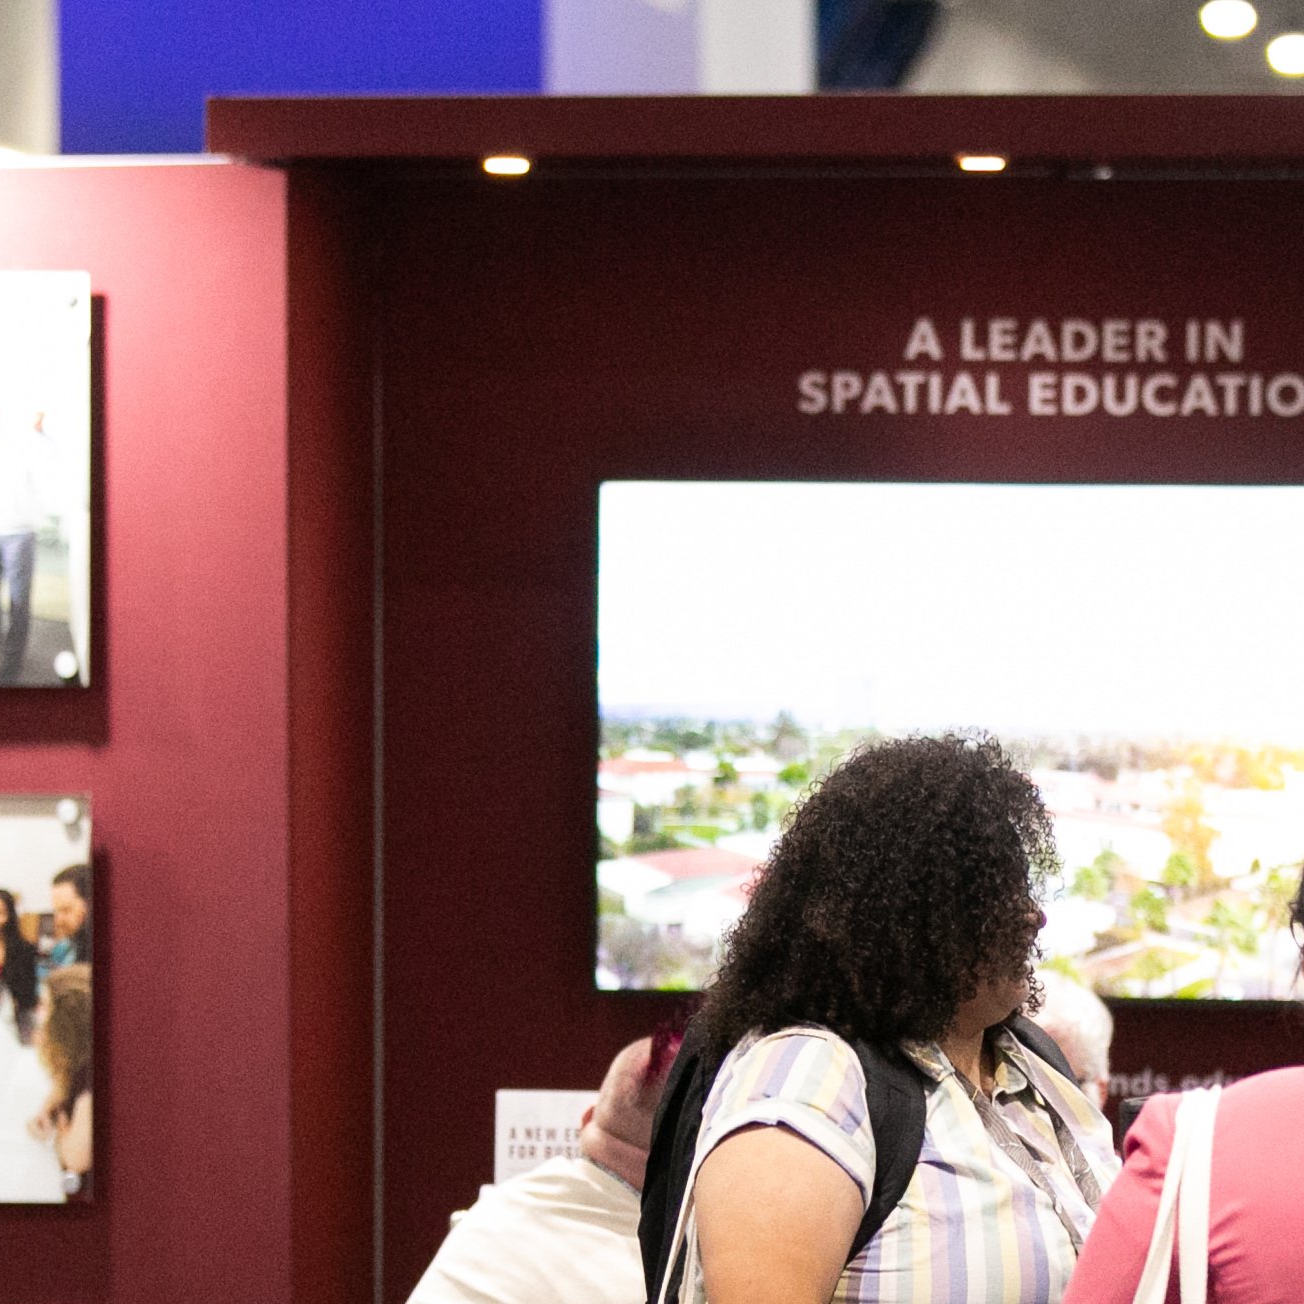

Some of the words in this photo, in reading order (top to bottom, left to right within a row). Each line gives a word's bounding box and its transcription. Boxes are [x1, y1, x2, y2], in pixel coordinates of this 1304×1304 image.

[904, 318, 944, 361] A
[959, 318, 1168, 363] LEADER
[1185, 319, 1245, 363] IN
[797, 371, 1012, 415] SPATIAL
[509, 1145, 537, 1160] FOR
